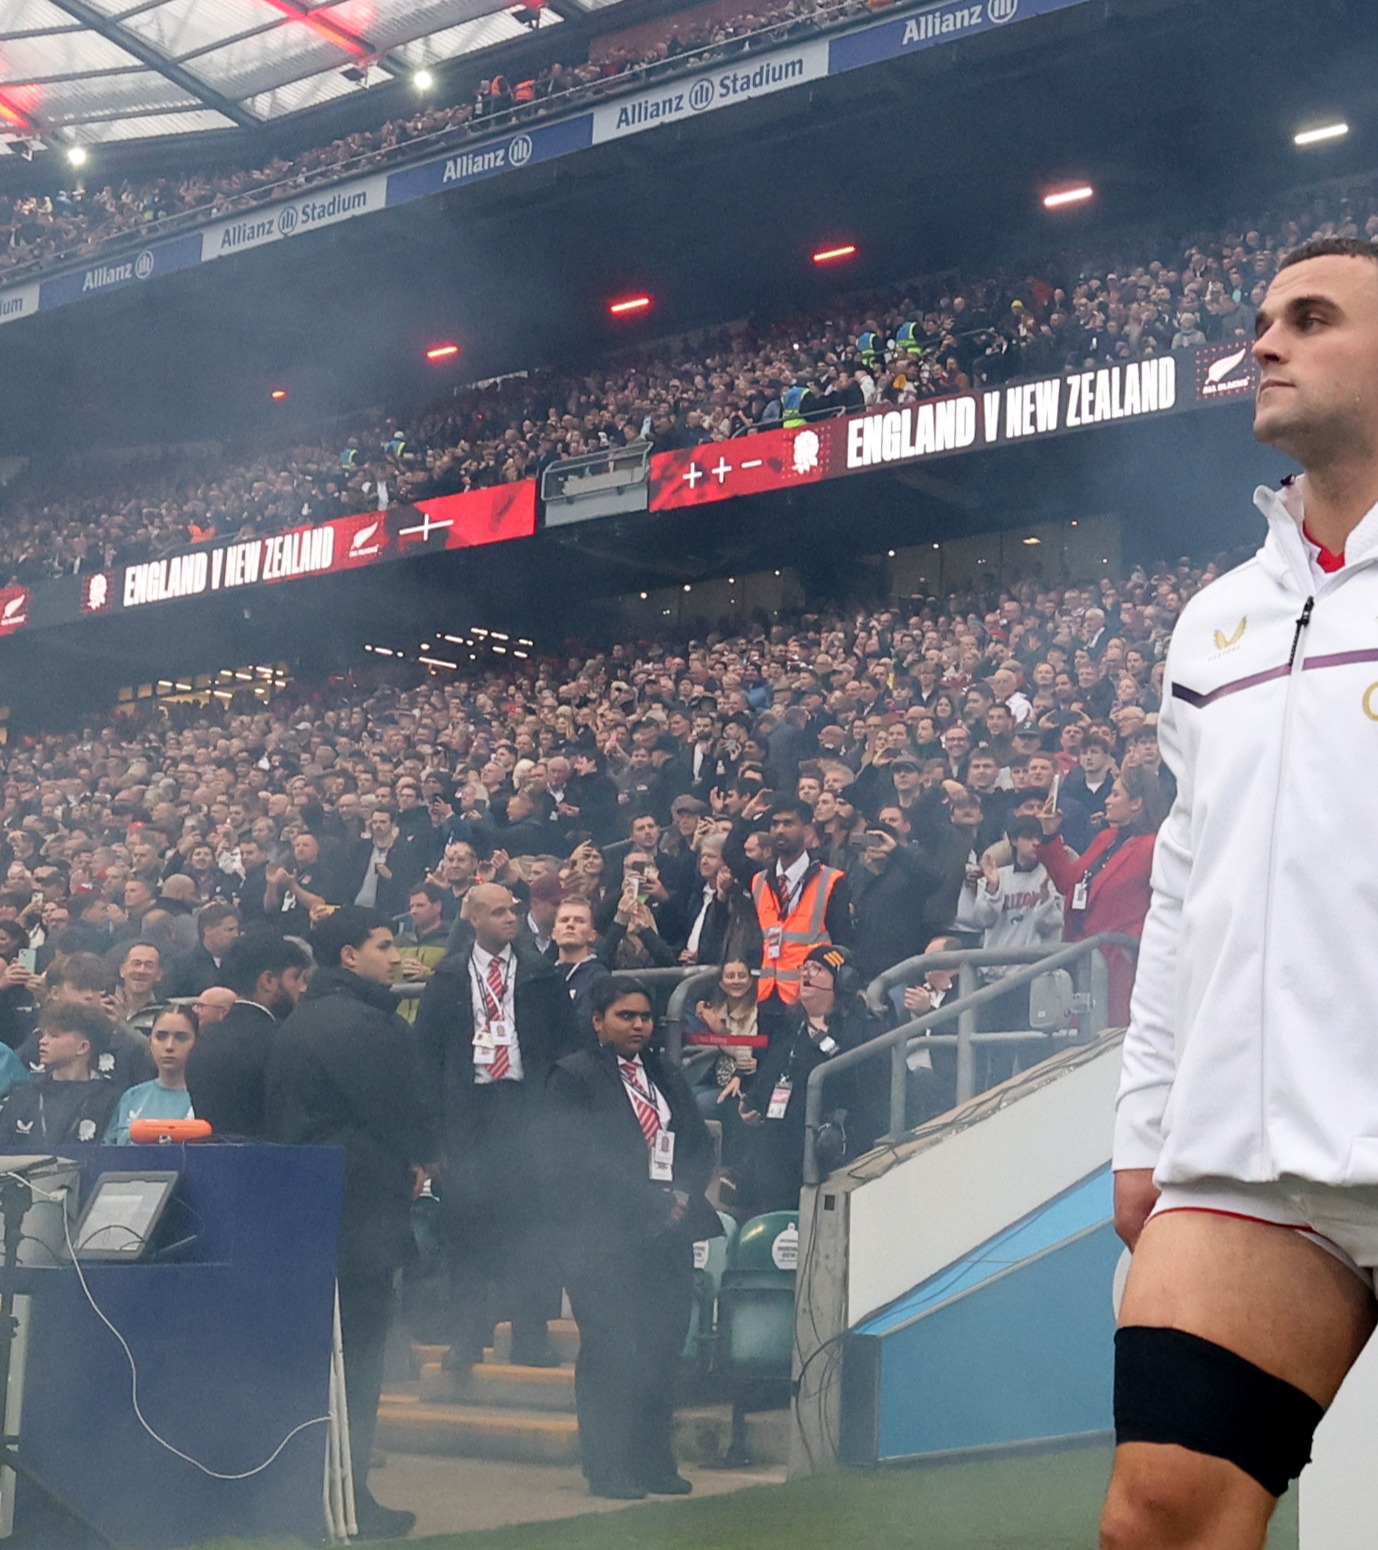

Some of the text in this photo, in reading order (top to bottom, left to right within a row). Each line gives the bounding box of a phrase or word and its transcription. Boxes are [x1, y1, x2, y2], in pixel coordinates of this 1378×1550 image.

[901, 4, 983, 46] Allianz
[615, 58, 804, 130] Allianz Stadium
[442, 149, 505, 183] Allianz
[220, 191, 367, 249] Allianz Stadium
[82, 261, 133, 292] Allianz
[846, 355, 1177, 469] ENGLAND V NEW ZEALAND
[122, 525, 335, 608] ENGLAND V NEW ZEALAND
